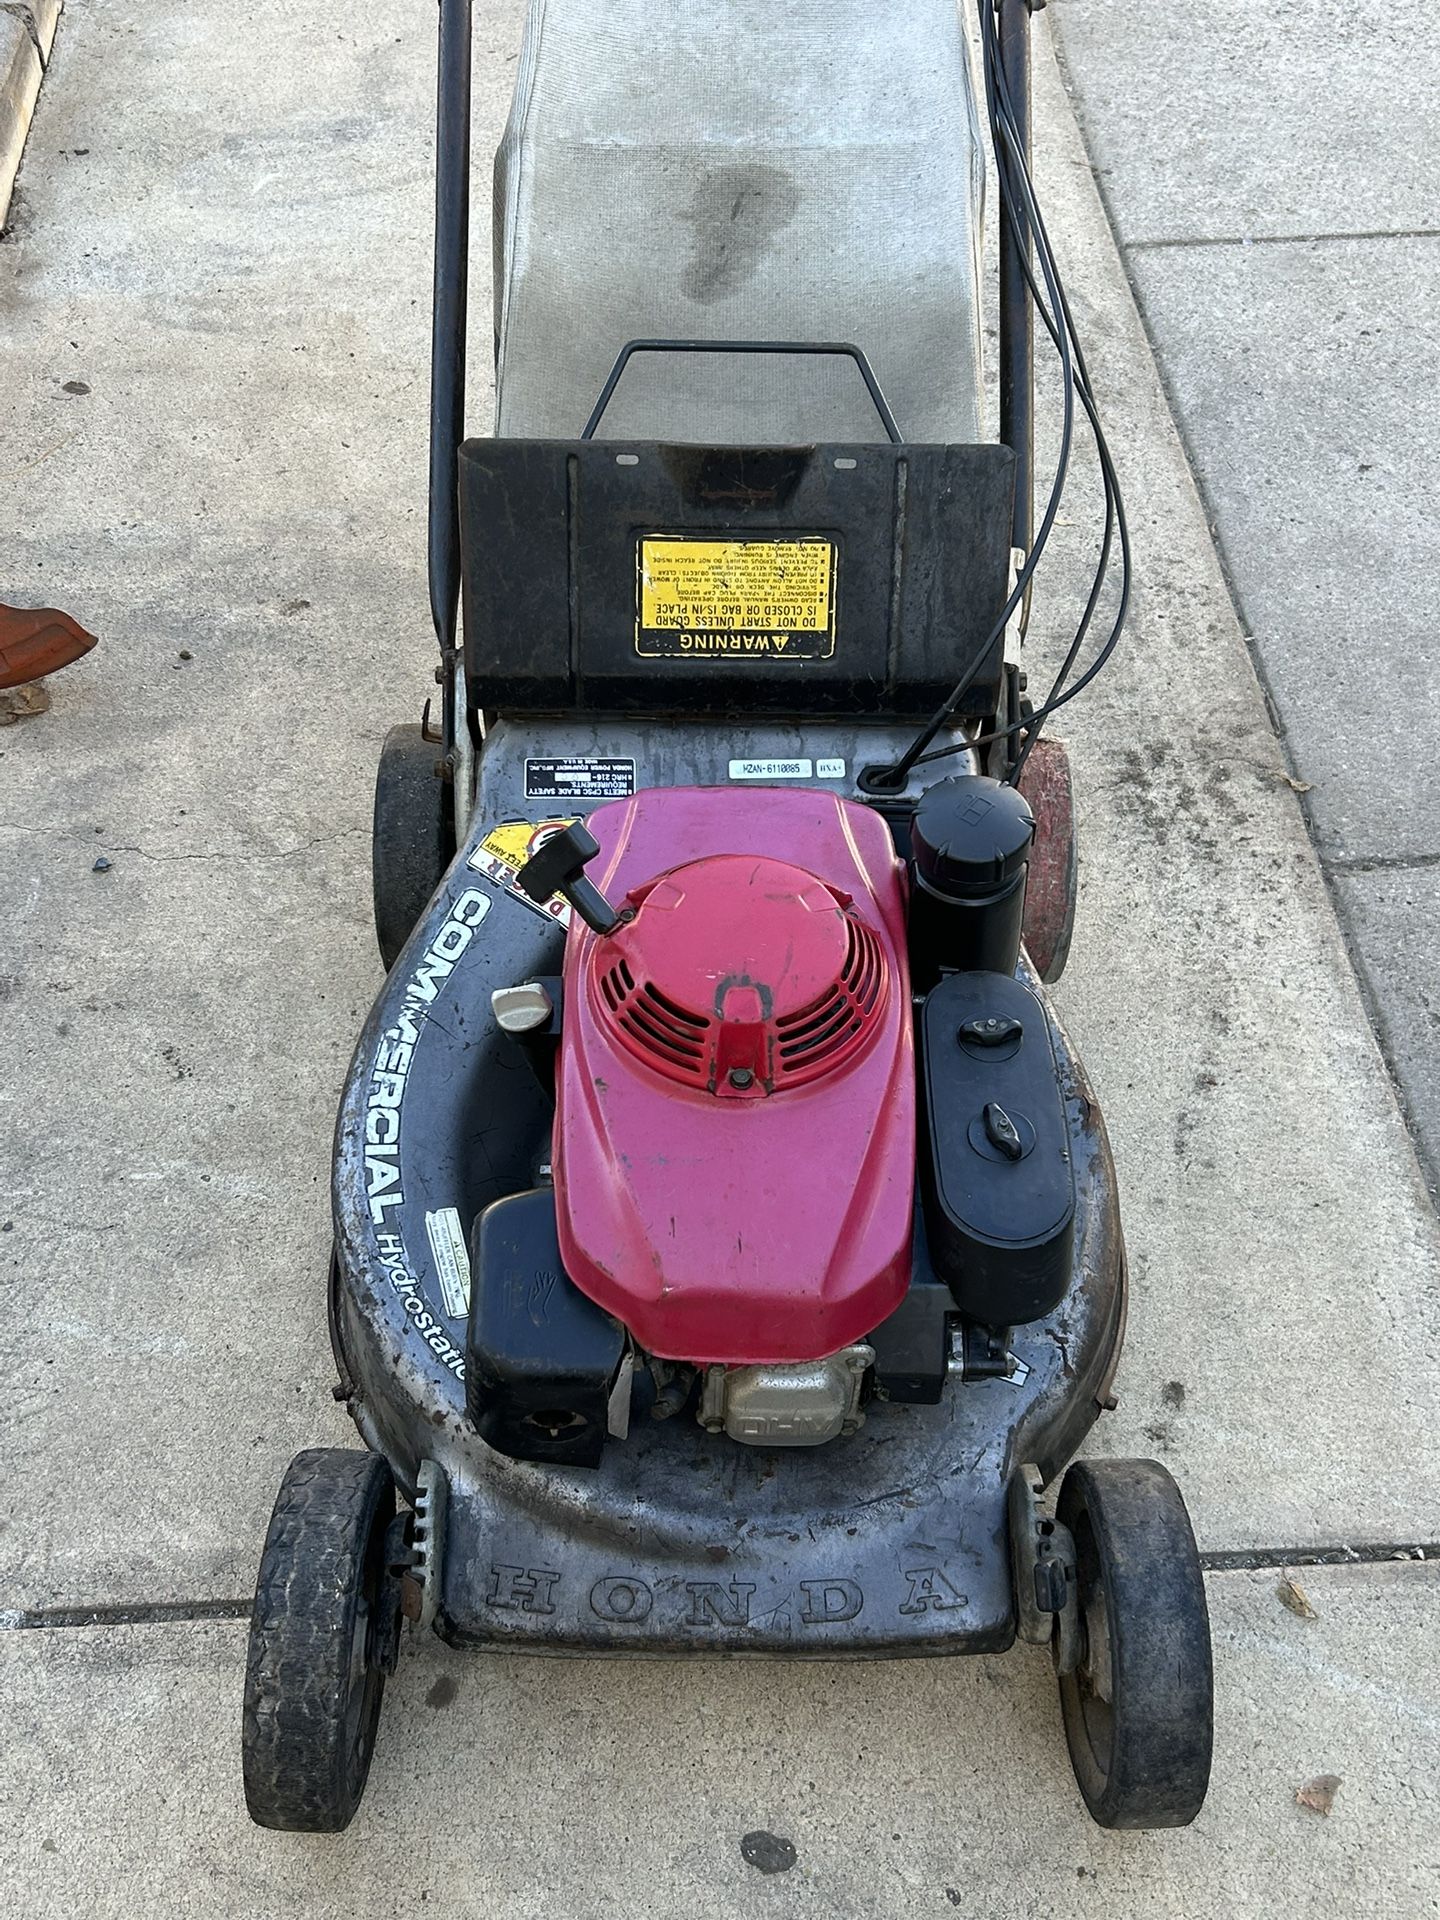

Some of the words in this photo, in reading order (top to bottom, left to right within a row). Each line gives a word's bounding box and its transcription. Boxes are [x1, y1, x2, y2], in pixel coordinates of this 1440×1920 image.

[722, 605, 741, 615] BAG
[746, 605, 760, 615] OR
[764, 605, 803, 615] CLOSED
[807, 606, 817, 615] IS
[655, 615, 690, 626] GUARD
[695, 616, 734, 626] UNLESS
[740, 616, 771, 626] START
[777, 617, 797, 626] NOT
[802, 617, 816, 626] DO
[680, 634, 770, 651] WARNING
[484, 842, 506, 857] AWAY
[365, 888, 491, 1225] COMMERCIAL
[456, 1250, 469, 1286] CAUTION
[486, 1563, 968, 1626] HONDA
